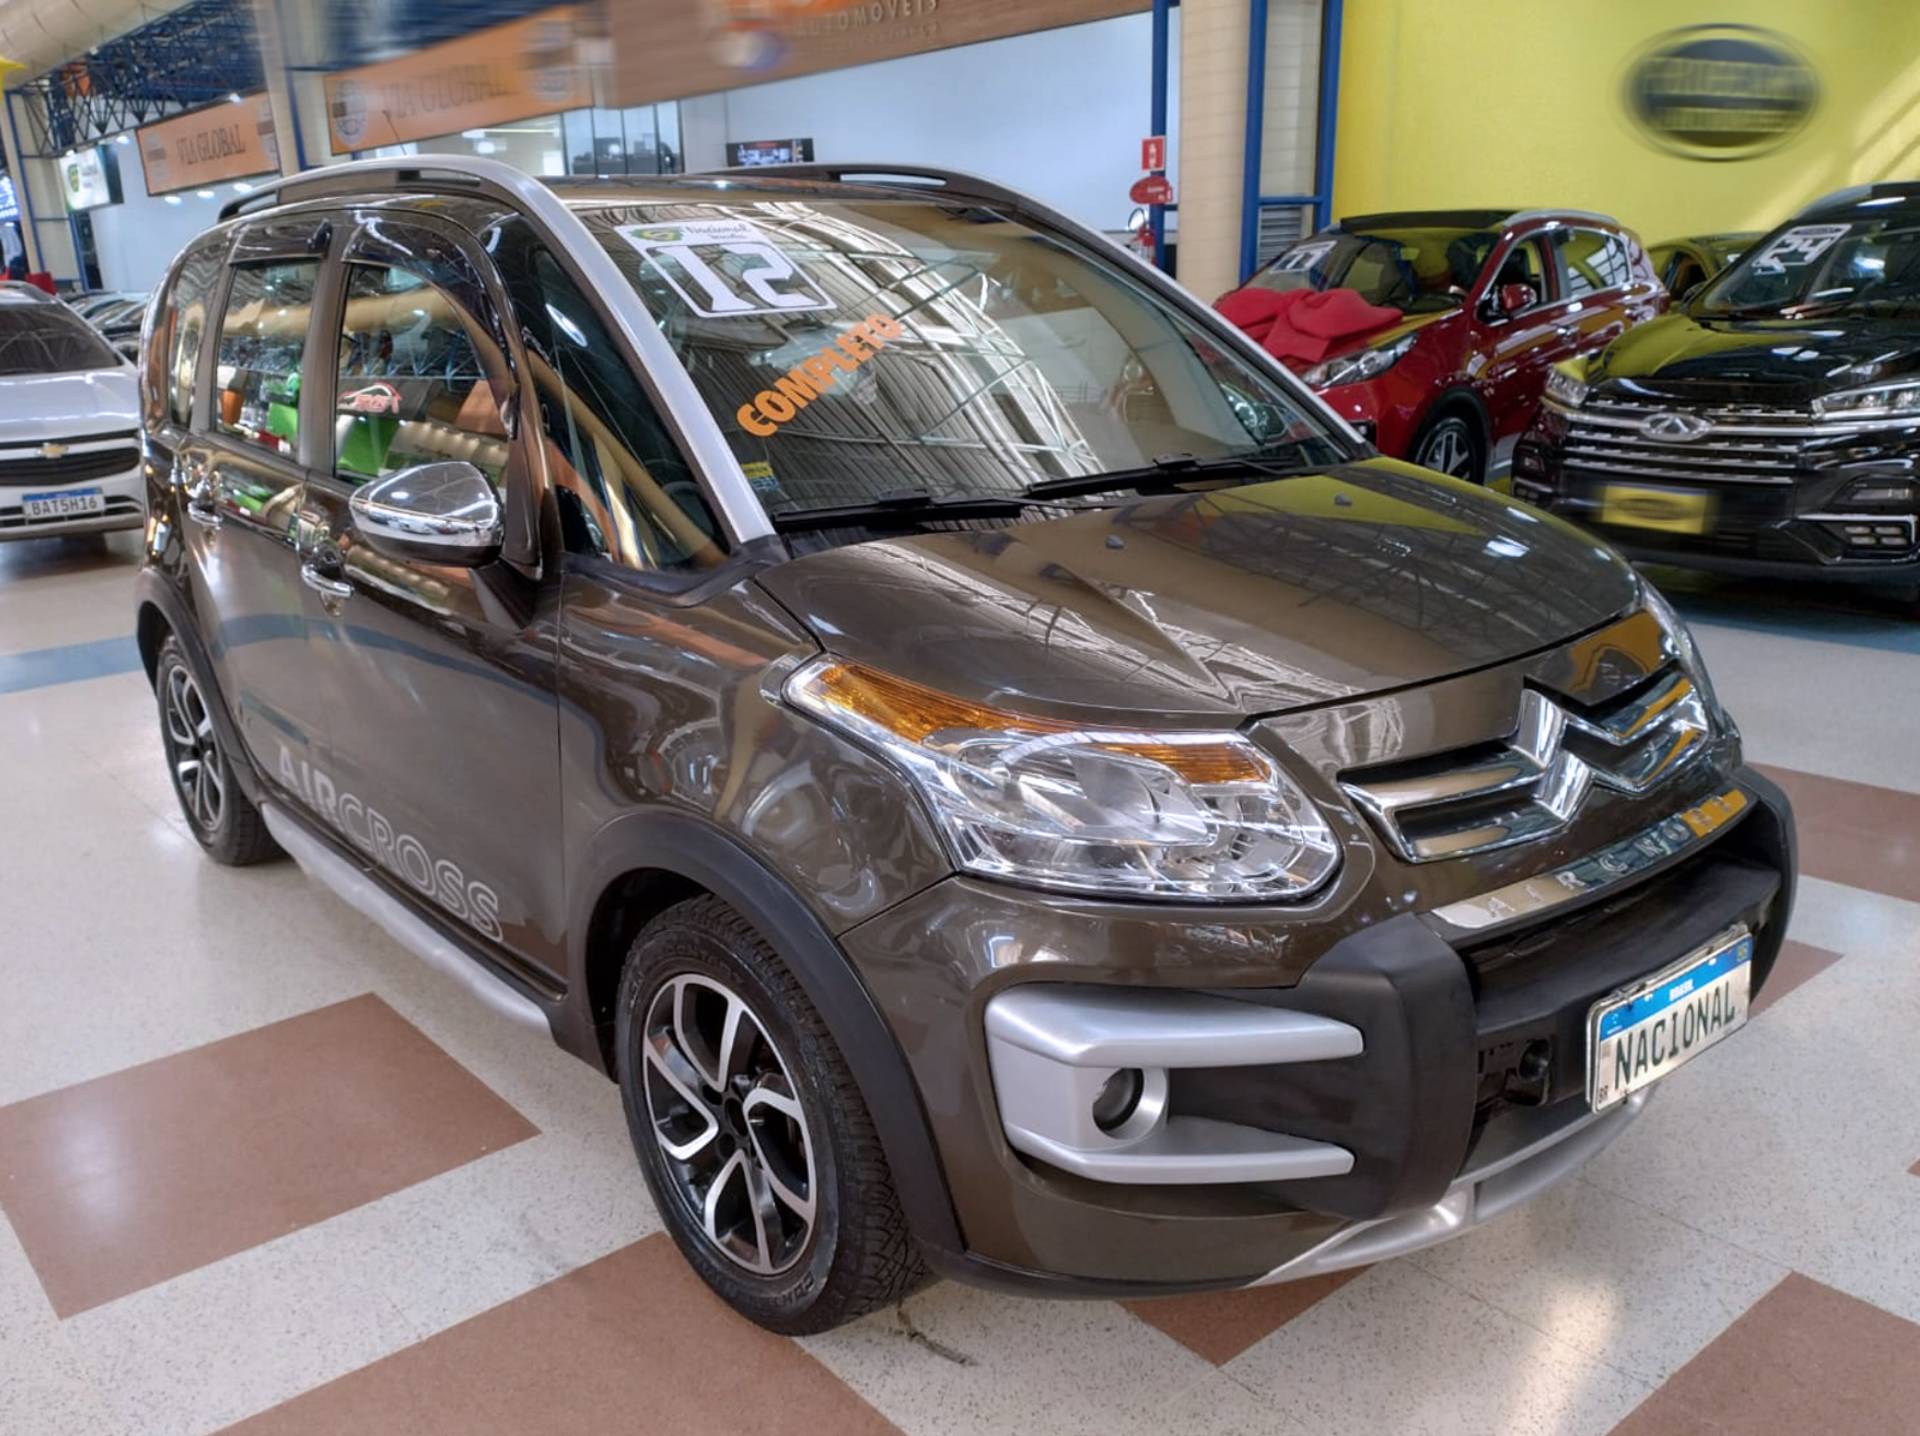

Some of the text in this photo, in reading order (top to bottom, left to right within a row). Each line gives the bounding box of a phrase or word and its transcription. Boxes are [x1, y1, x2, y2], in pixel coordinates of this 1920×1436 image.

[655, 245, 819, 312] 12
[736, 312, 902, 437] COMPLETO
[279, 744, 504, 943] AIRCROSS
[1615, 981, 1736, 1090] NACIONAL
